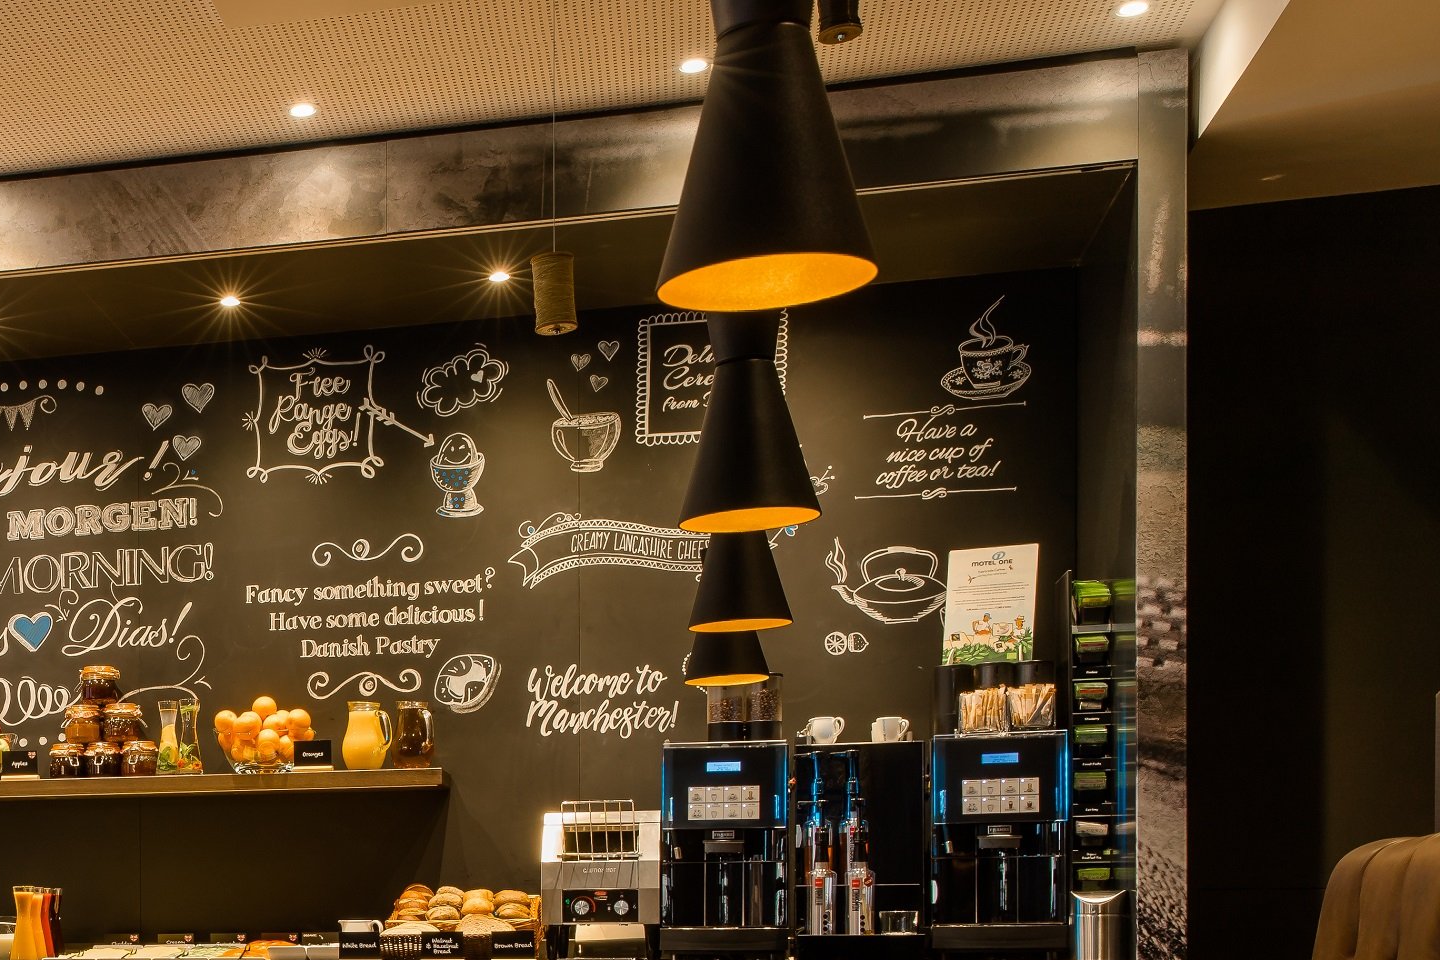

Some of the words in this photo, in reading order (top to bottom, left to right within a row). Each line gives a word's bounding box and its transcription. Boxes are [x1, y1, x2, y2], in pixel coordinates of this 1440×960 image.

[662, 344, 715, 367] Deli
[289, 367, 351, 402] Free
[663, 365, 715, 391] Cere
[268, 395, 352, 434] Range
[662, 396, 700, 413] from
[287, 412, 361, 459] Eggs!
[897, 415, 956, 442] Have
[960, 424, 978, 436] a
[886, 448, 927, 463] nice
[929, 447, 964, 463] cup
[969, 438, 994, 462] of
[875, 464, 928, 489] coffee
[930, 466, 955, 481] or
[958, 460, 1001, 478] tea!
[6, 497, 198, 541] MORGEN!
[571, 532, 610, 553] CREAMY
[614, 533, 674, 559] LANCASHIRE
[245, 584, 308, 606] Fancy
[314, 575, 420, 601] something
[424, 566, 495, 595] sweet?
[61, 597, 193, 656] Dias!
[269, 612, 322, 631] Have
[326, 611, 380, 628] some
[384, 599, 485, 627] delicious!
[300, 635, 370, 658] Danish
[375, 635, 440, 658] Pastry
[527, 663, 634, 701] Welcome
[636, 664, 667, 694] to
[526, 700, 679, 739] Manchester!
